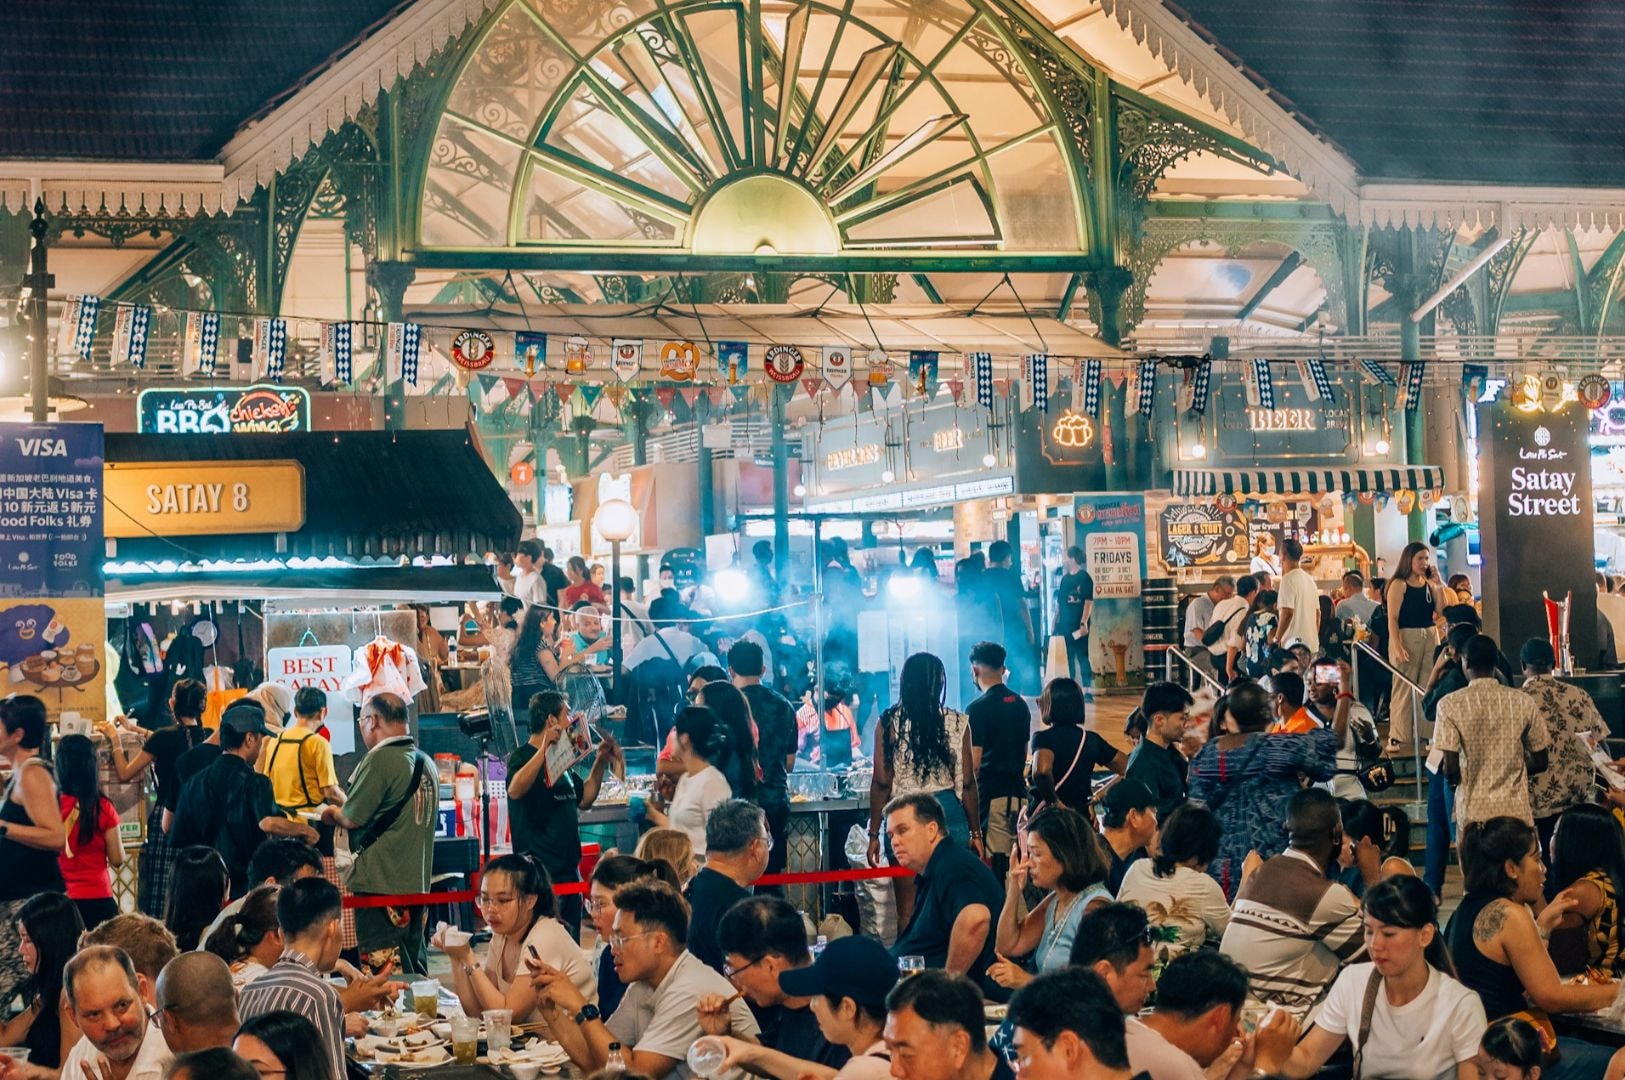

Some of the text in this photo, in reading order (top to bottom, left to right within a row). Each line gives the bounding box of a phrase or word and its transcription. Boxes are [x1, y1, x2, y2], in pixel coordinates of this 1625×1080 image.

[455, 331, 490, 349] ERDINGER
[766, 345, 801, 362] ERDINGER
[1250, 409, 1317, 431] BEER
[15, 438, 68, 457] VISA
[1511, 466, 1576, 496] Satay
[56, 488, 84, 500] Visa
[86, 487, 98, 500] 卡
[146, 482, 248, 514] SATAY 8
[5, 502, 19, 513] 10
[61, 502, 69, 513] 5
[70, 501, 97, 514] 新元
[1508, 492, 1581, 517] Street
[0, 515, 92, 528] ood Folks 礼券
[1168, 522, 1222, 534] LAGER & STOUT
[54, 552, 77, 561] FOOD
[1094, 551, 1132, 564] FRIDAYS
[1103, 585, 1134, 594] LAU PA SAT
[282, 656, 338, 675] BEST
